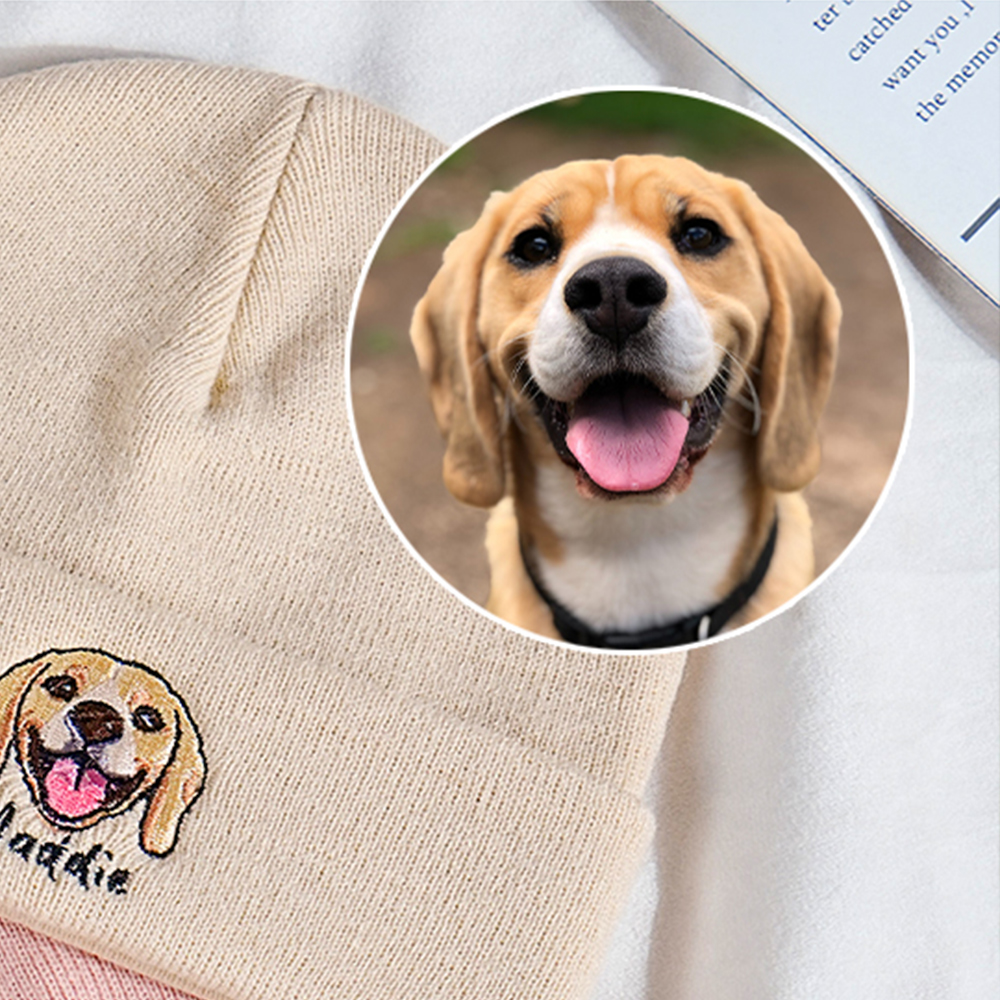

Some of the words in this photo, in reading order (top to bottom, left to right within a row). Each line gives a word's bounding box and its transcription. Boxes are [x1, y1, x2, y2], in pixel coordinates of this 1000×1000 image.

[812, 3, 840, 32] ter
[882, 48, 928, 90] want
[924, 15, 960, 54] you
[915, 92, 948, 122] the
